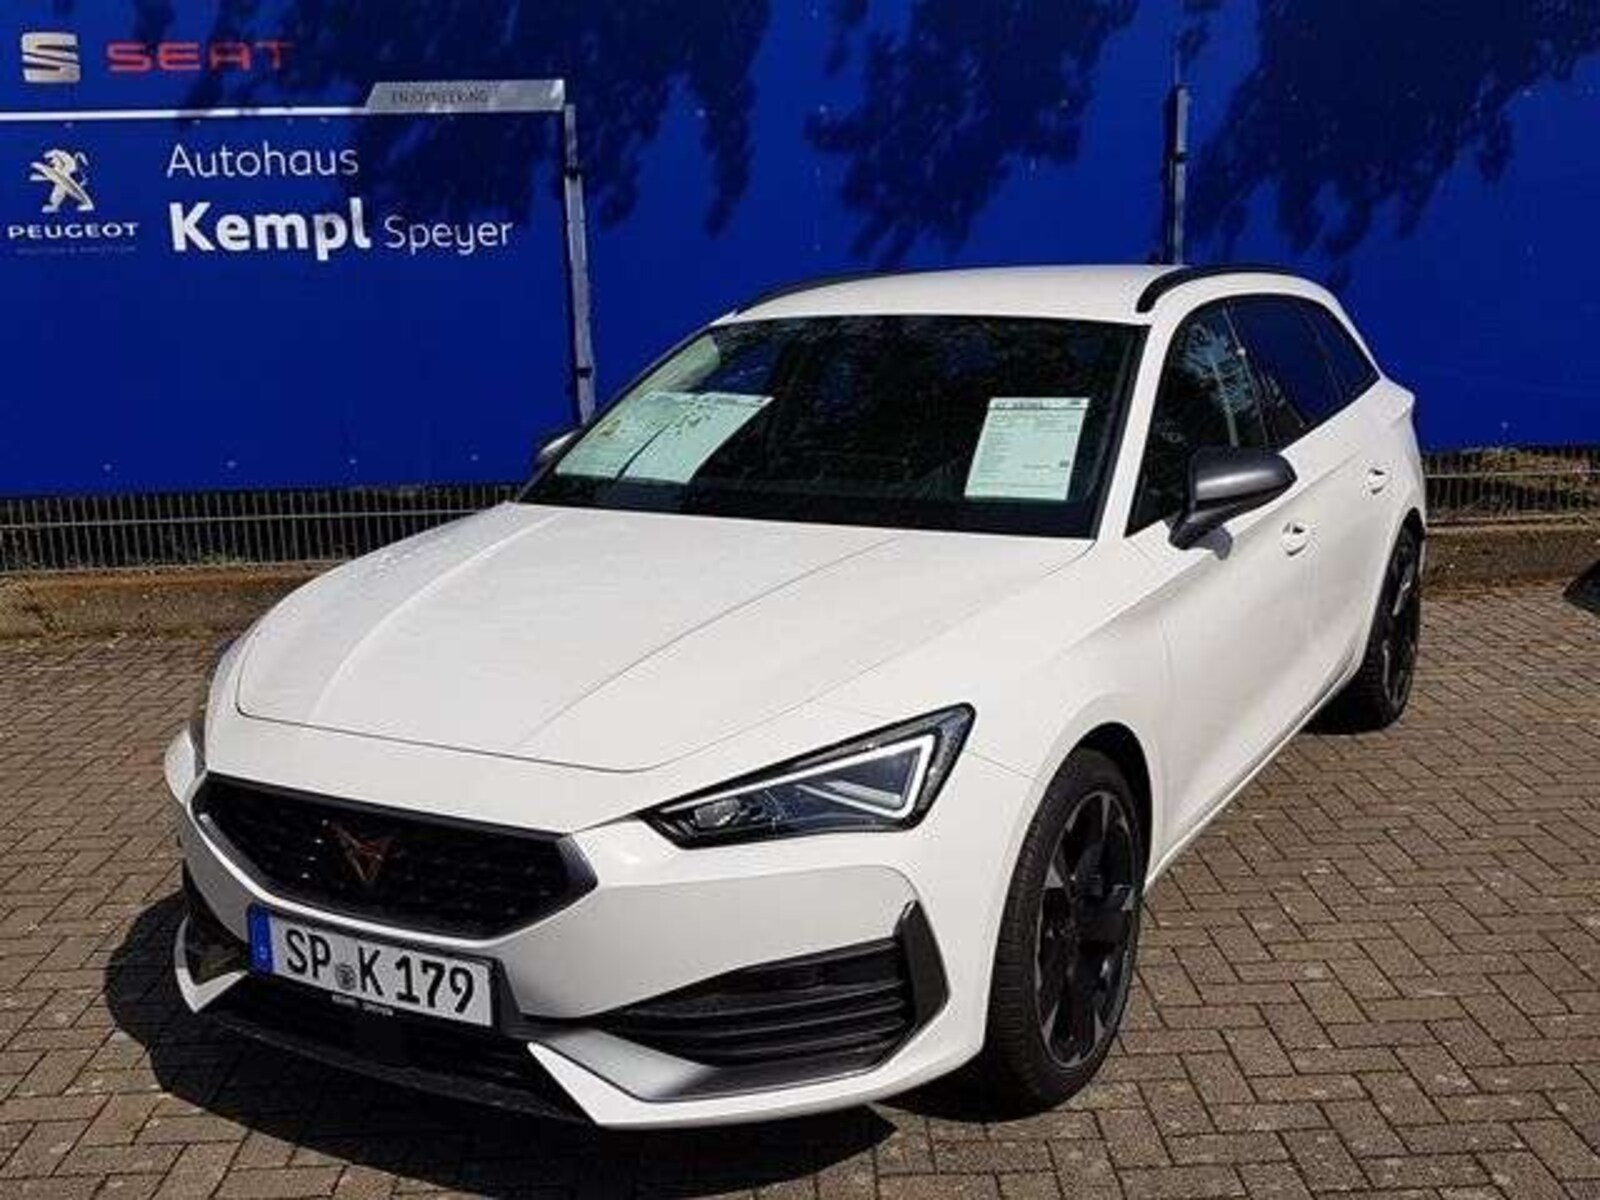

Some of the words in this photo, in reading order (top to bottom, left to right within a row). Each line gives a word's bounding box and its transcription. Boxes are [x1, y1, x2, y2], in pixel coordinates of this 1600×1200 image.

[106, 42, 291, 72] SEAT
[166, 141, 360, 179] Autohaus
[7, 222, 139, 240] PEUGEOT
[169, 197, 372, 261] Kempl
[383, 215, 514, 255] Speyer
[285, 929, 331, 979] SP
[358, 946, 385, 996] K
[395, 954, 475, 1013] 179
